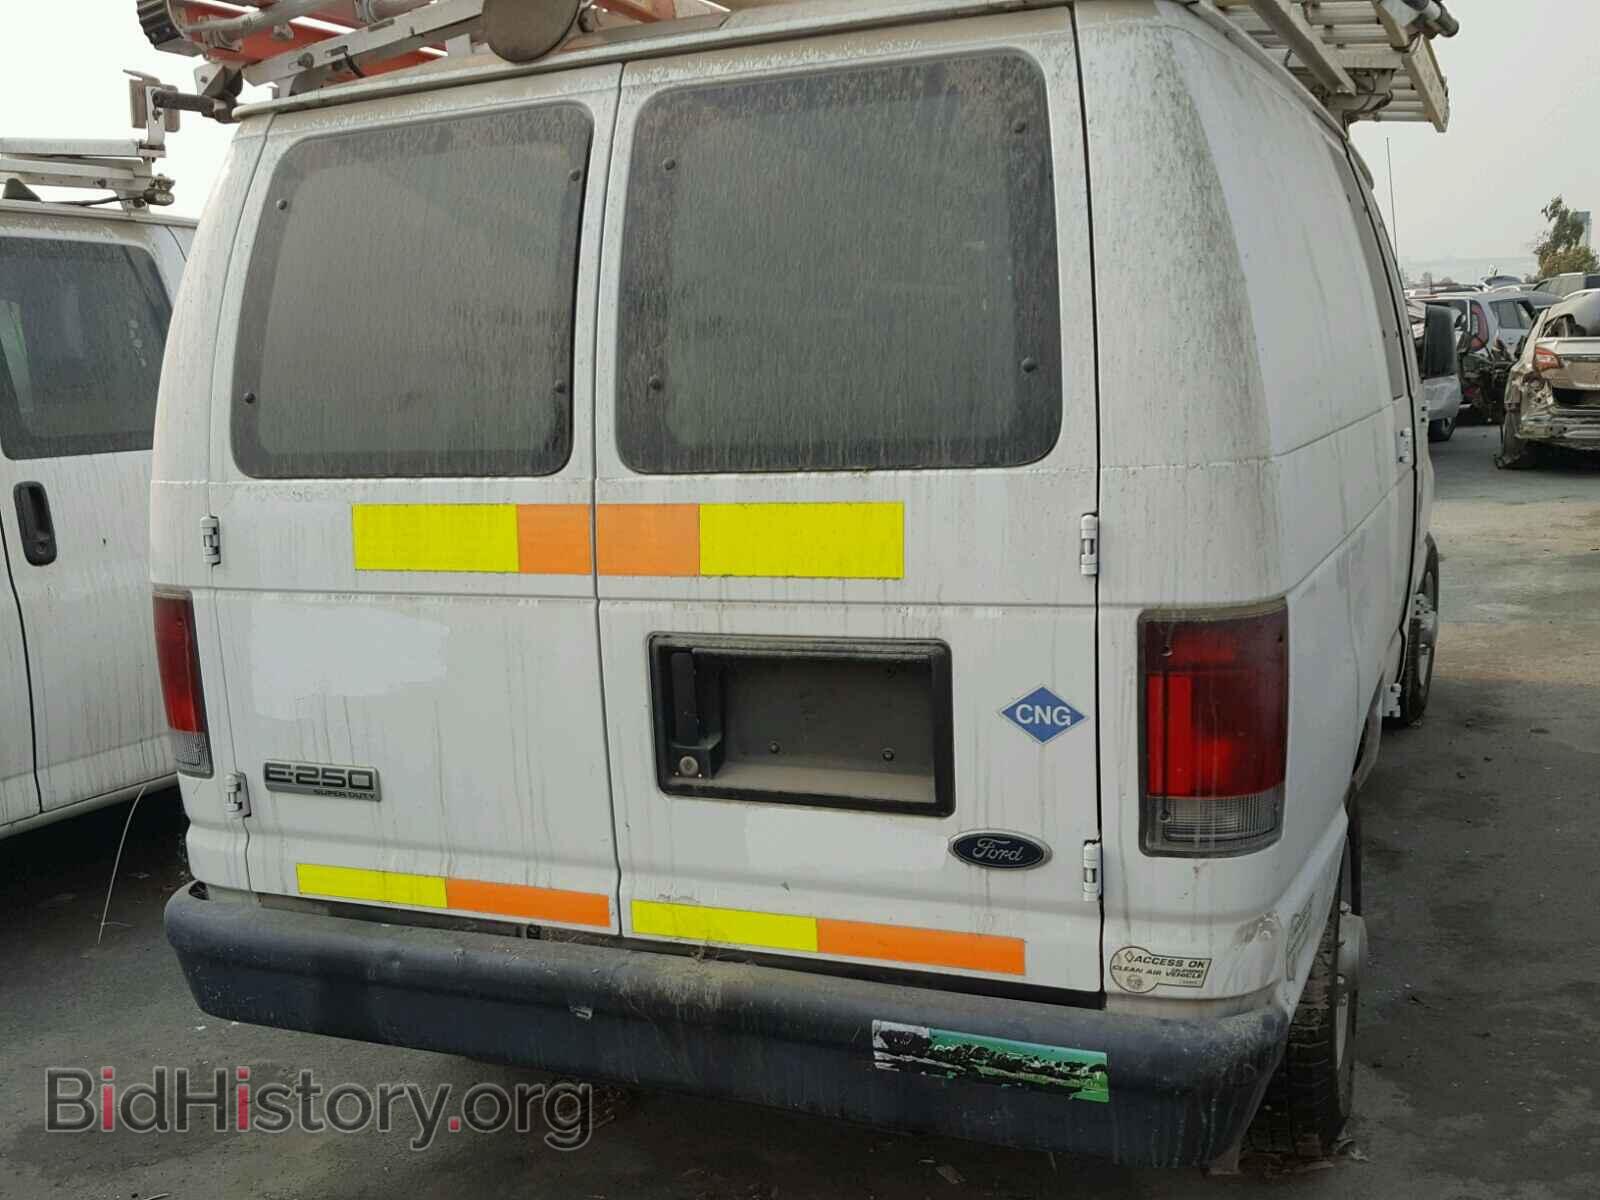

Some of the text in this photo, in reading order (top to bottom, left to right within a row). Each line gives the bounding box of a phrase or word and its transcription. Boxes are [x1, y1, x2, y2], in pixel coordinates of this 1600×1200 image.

[1015, 704, 1072, 726] CNG
[350, 790, 376, 800] DUTY
[972, 837, 1024, 862] Ford
[1134, 955, 1184, 968] ACCESS
[1112, 964, 1202, 979] CLEAN AIR VEHICLE
